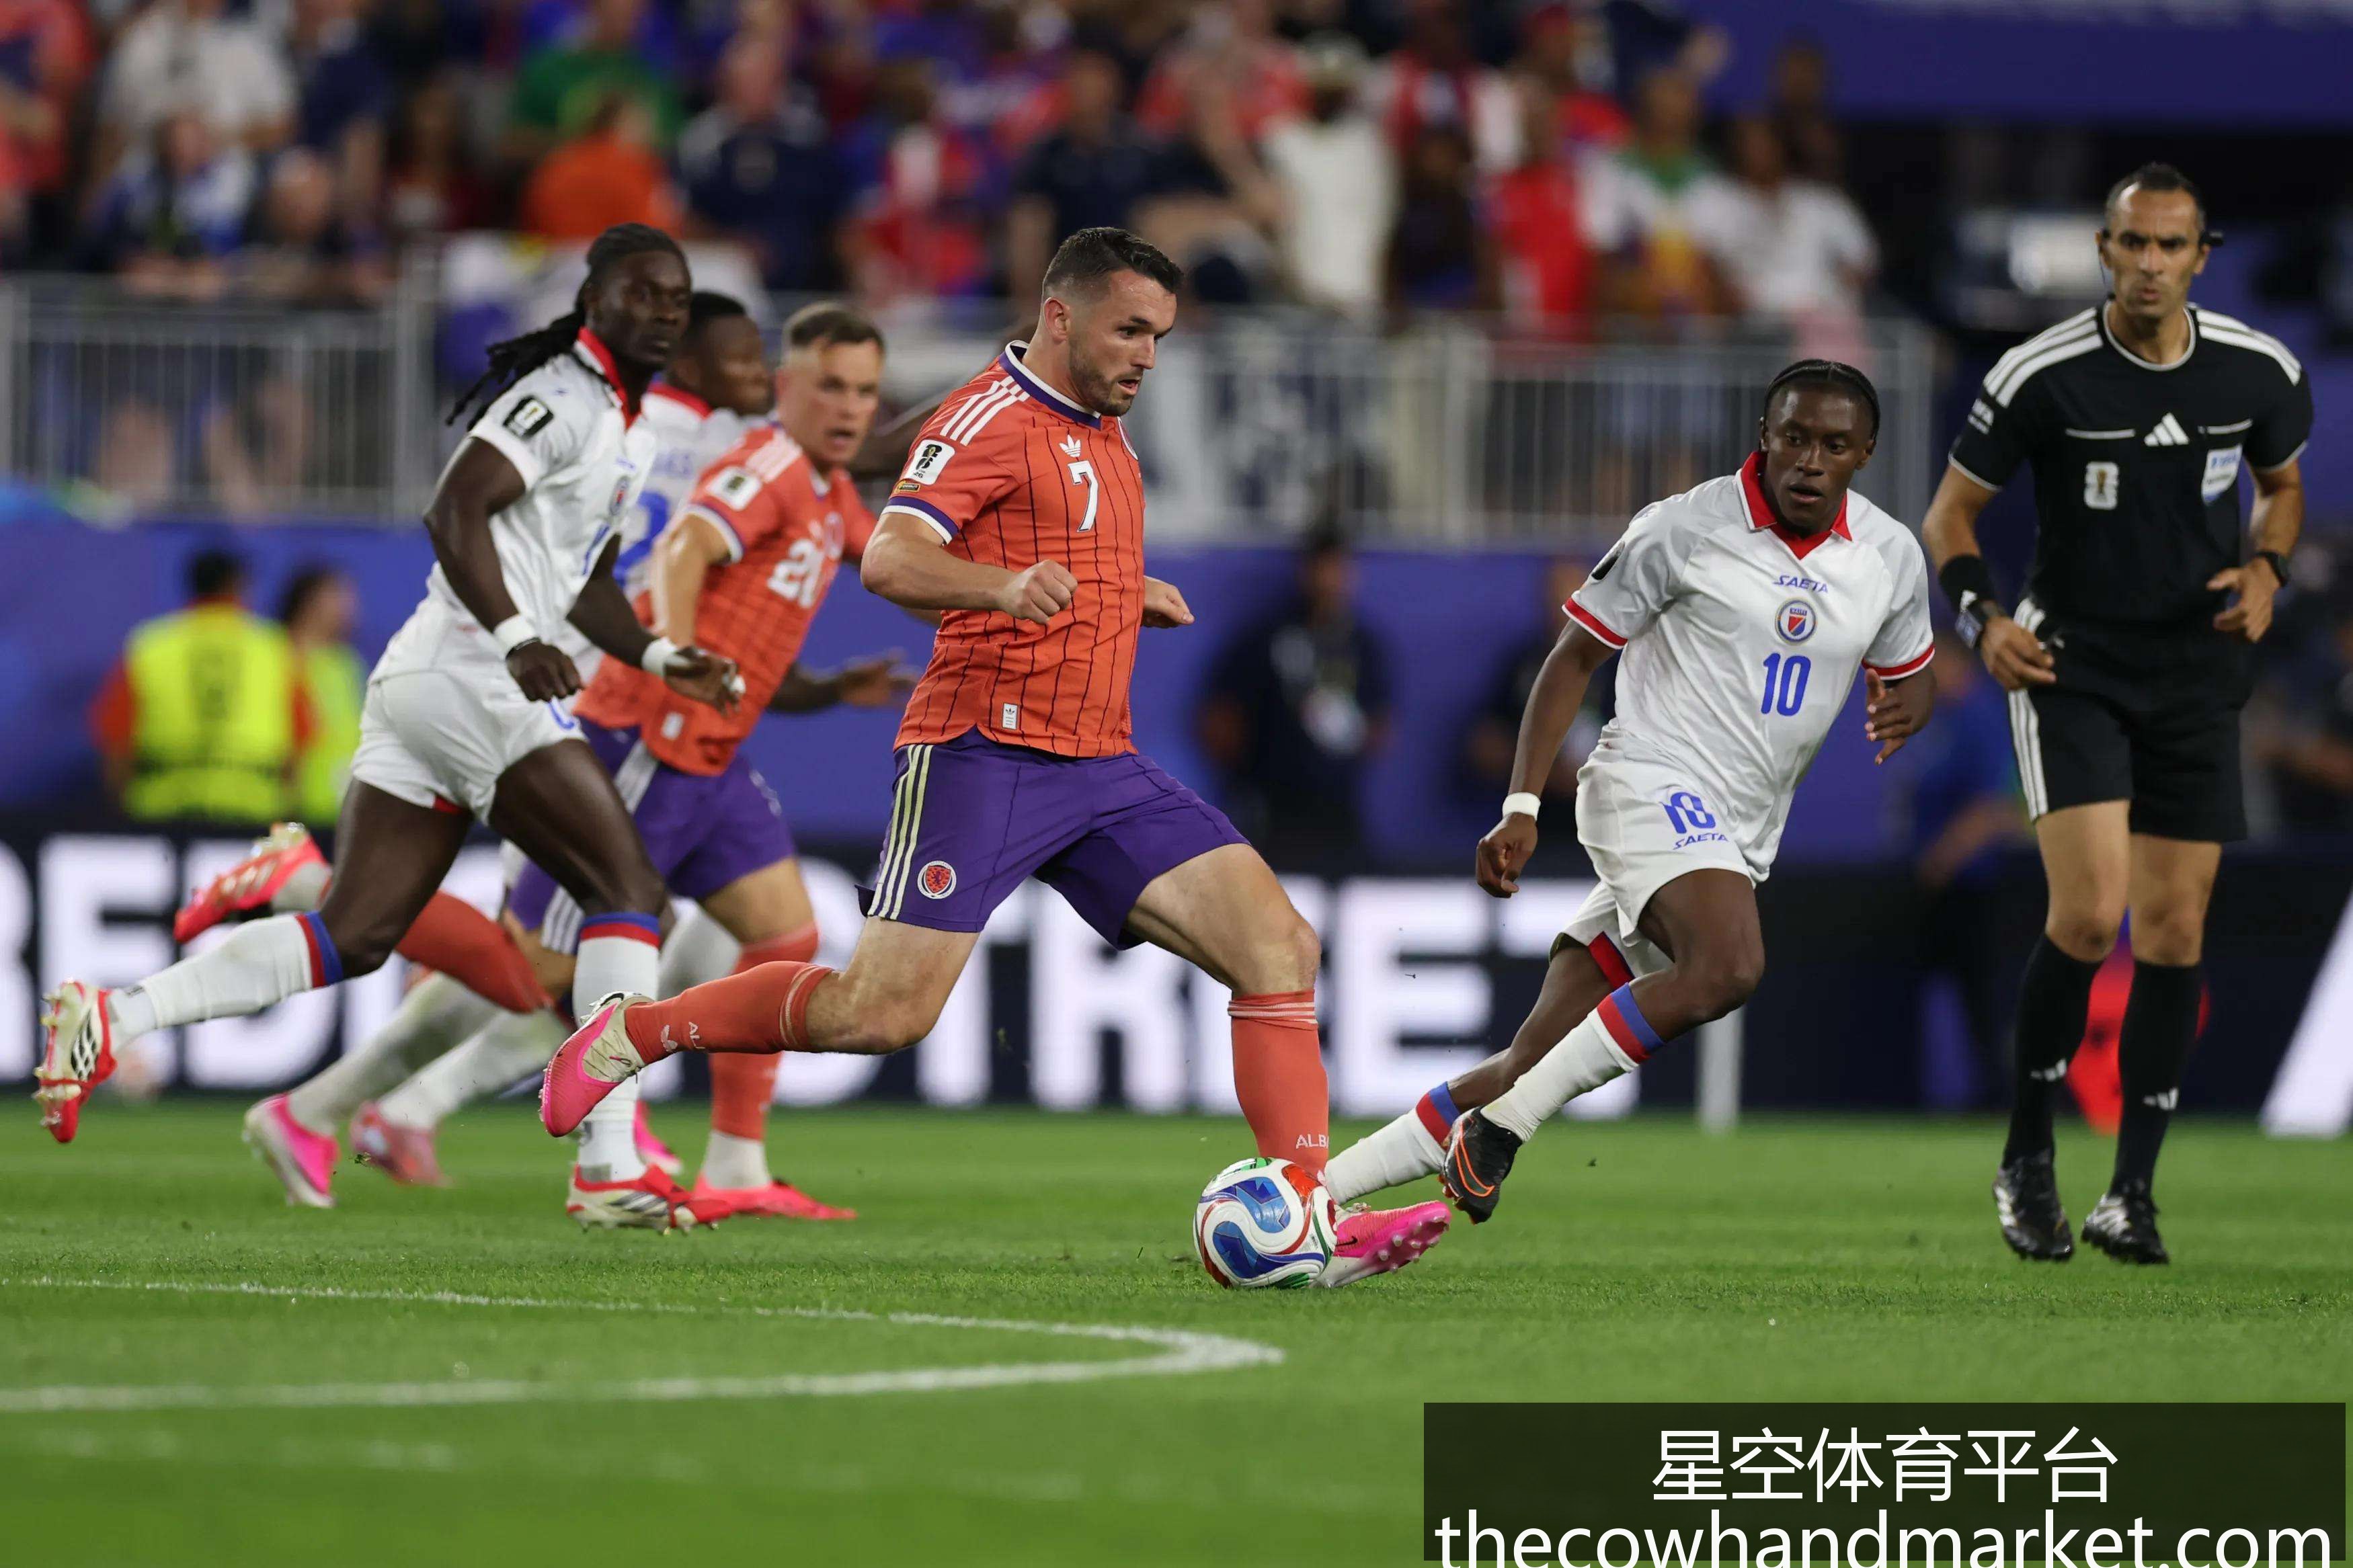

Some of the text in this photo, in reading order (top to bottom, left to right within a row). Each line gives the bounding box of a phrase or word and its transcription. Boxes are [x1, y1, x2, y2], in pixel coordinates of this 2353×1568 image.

[1067, 460, 1099, 533] 7
[1772, 575, 1829, 593] SAETA
[1761, 653, 1811, 717] 10
[1672, 832, 1730, 850] SAETA
[688, 1021, 705, 1050] AL
[1295, 1133, 1329, 1149] ALB
